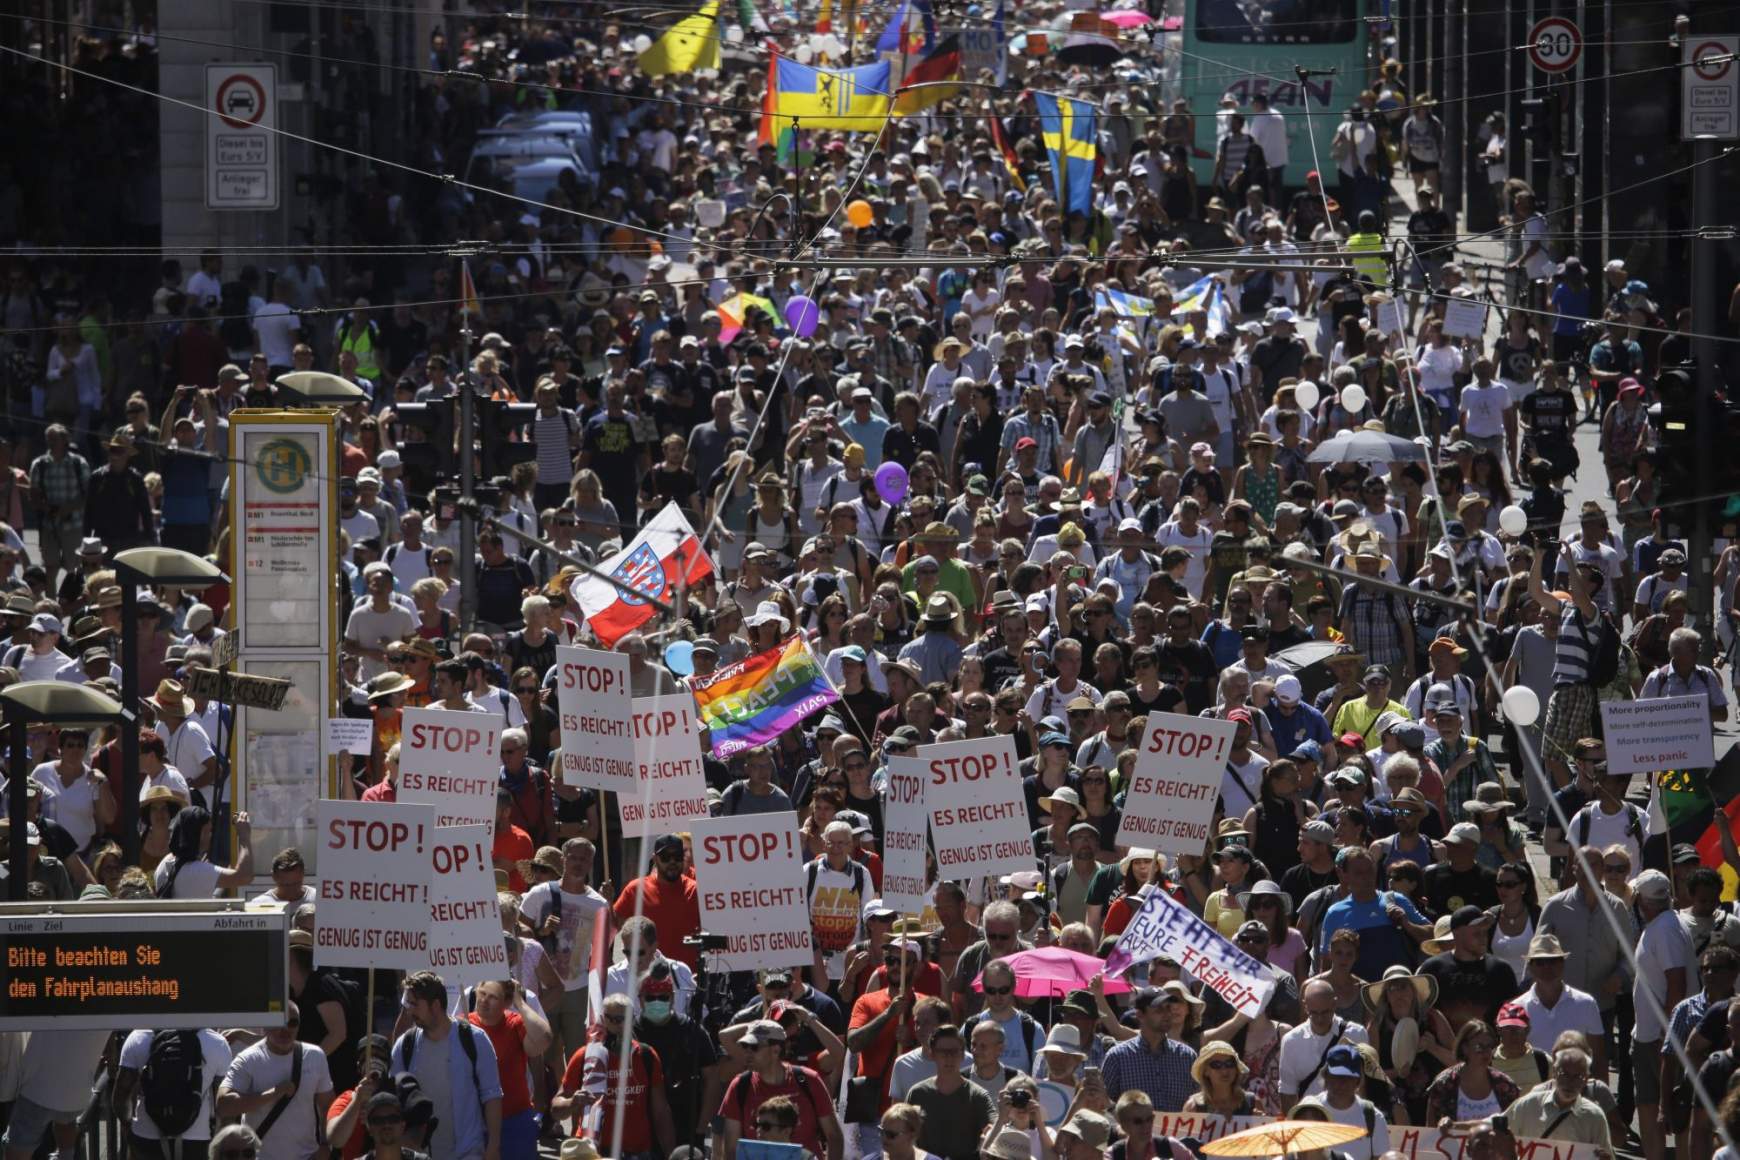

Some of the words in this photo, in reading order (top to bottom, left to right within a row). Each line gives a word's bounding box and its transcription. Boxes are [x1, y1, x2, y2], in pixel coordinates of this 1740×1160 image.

[1540, 33, 1570, 57] 30
[220, 139, 247, 149] Diesel
[250, 139, 263, 149] bis
[220, 152, 242, 161] Euro
[222, 175, 261, 185] Anlieger
[1609, 706, 1632, 715] More
[1634, 701, 1701, 714] proportionality
[563, 714, 577, 731] ES
[580, 716, 624, 737] REICHT
[632, 711, 677, 739] TOP
[1609, 722, 1630, 730] More
[1632, 717, 1703, 729] self-determination
[1617, 737, 1640, 745] More
[1642, 733, 1700, 745] transparency
[564, 754, 592, 773] GENUG
[593, 757, 604, 774] IST
[606, 758, 633, 778] GENUG
[1633, 754, 1656, 763] Less
[1658, 750, 1688, 763] panic
[403, 774, 422, 790] ES
[427, 776, 487, 795] REICHT
[1134, 777, 1153, 793] ES
[1155, 780, 1210, 800] REICHT
[657, 801, 671, 818] IST
[673, 798, 707, 816] GENUG
[934, 809, 954, 827] ES
[957, 802, 1015, 824] REICHT
[1123, 815, 1156, 834] GENUG
[1157, 818, 1173, 835] IST
[1174, 821, 1207, 840] GENUG
[886, 830, 894, 849] ES
[896, 831, 921, 850] REICHT
[939, 847, 976, 866] GENUG
[977, 844, 993, 861] IST
[996, 840, 1032, 859] GENUG
[321, 880, 344, 899] ES
[350, 882, 419, 903] REICHT
[704, 893, 725, 911] ES
[731, 887, 794, 909] REICHT
[9, 921, 33, 932] Linie
[44, 920, 63, 931] Ziel
[214, 918, 255, 929] Abfahrt
[257, 918, 267, 928] in
[1133, 915, 1177, 953] EURE
[318, 927, 360, 949] GENUG
[363, 929, 381, 949] IST
[384, 930, 427, 951] GENUG
[750, 933, 766, 951] IST
[769, 931, 809, 950] GENUG
[1119, 932, 1155, 956] AUF
[8, 947, 46, 967] Bitte
[56, 946, 128, 966] beachten
[136, 945, 161, 965] Sie
[447, 947, 463, 966] IST
[466, 945, 504, 965] GENUG
[9, 978, 36, 998] den
[44, 975, 179, 1001] Fahrplanaushang
